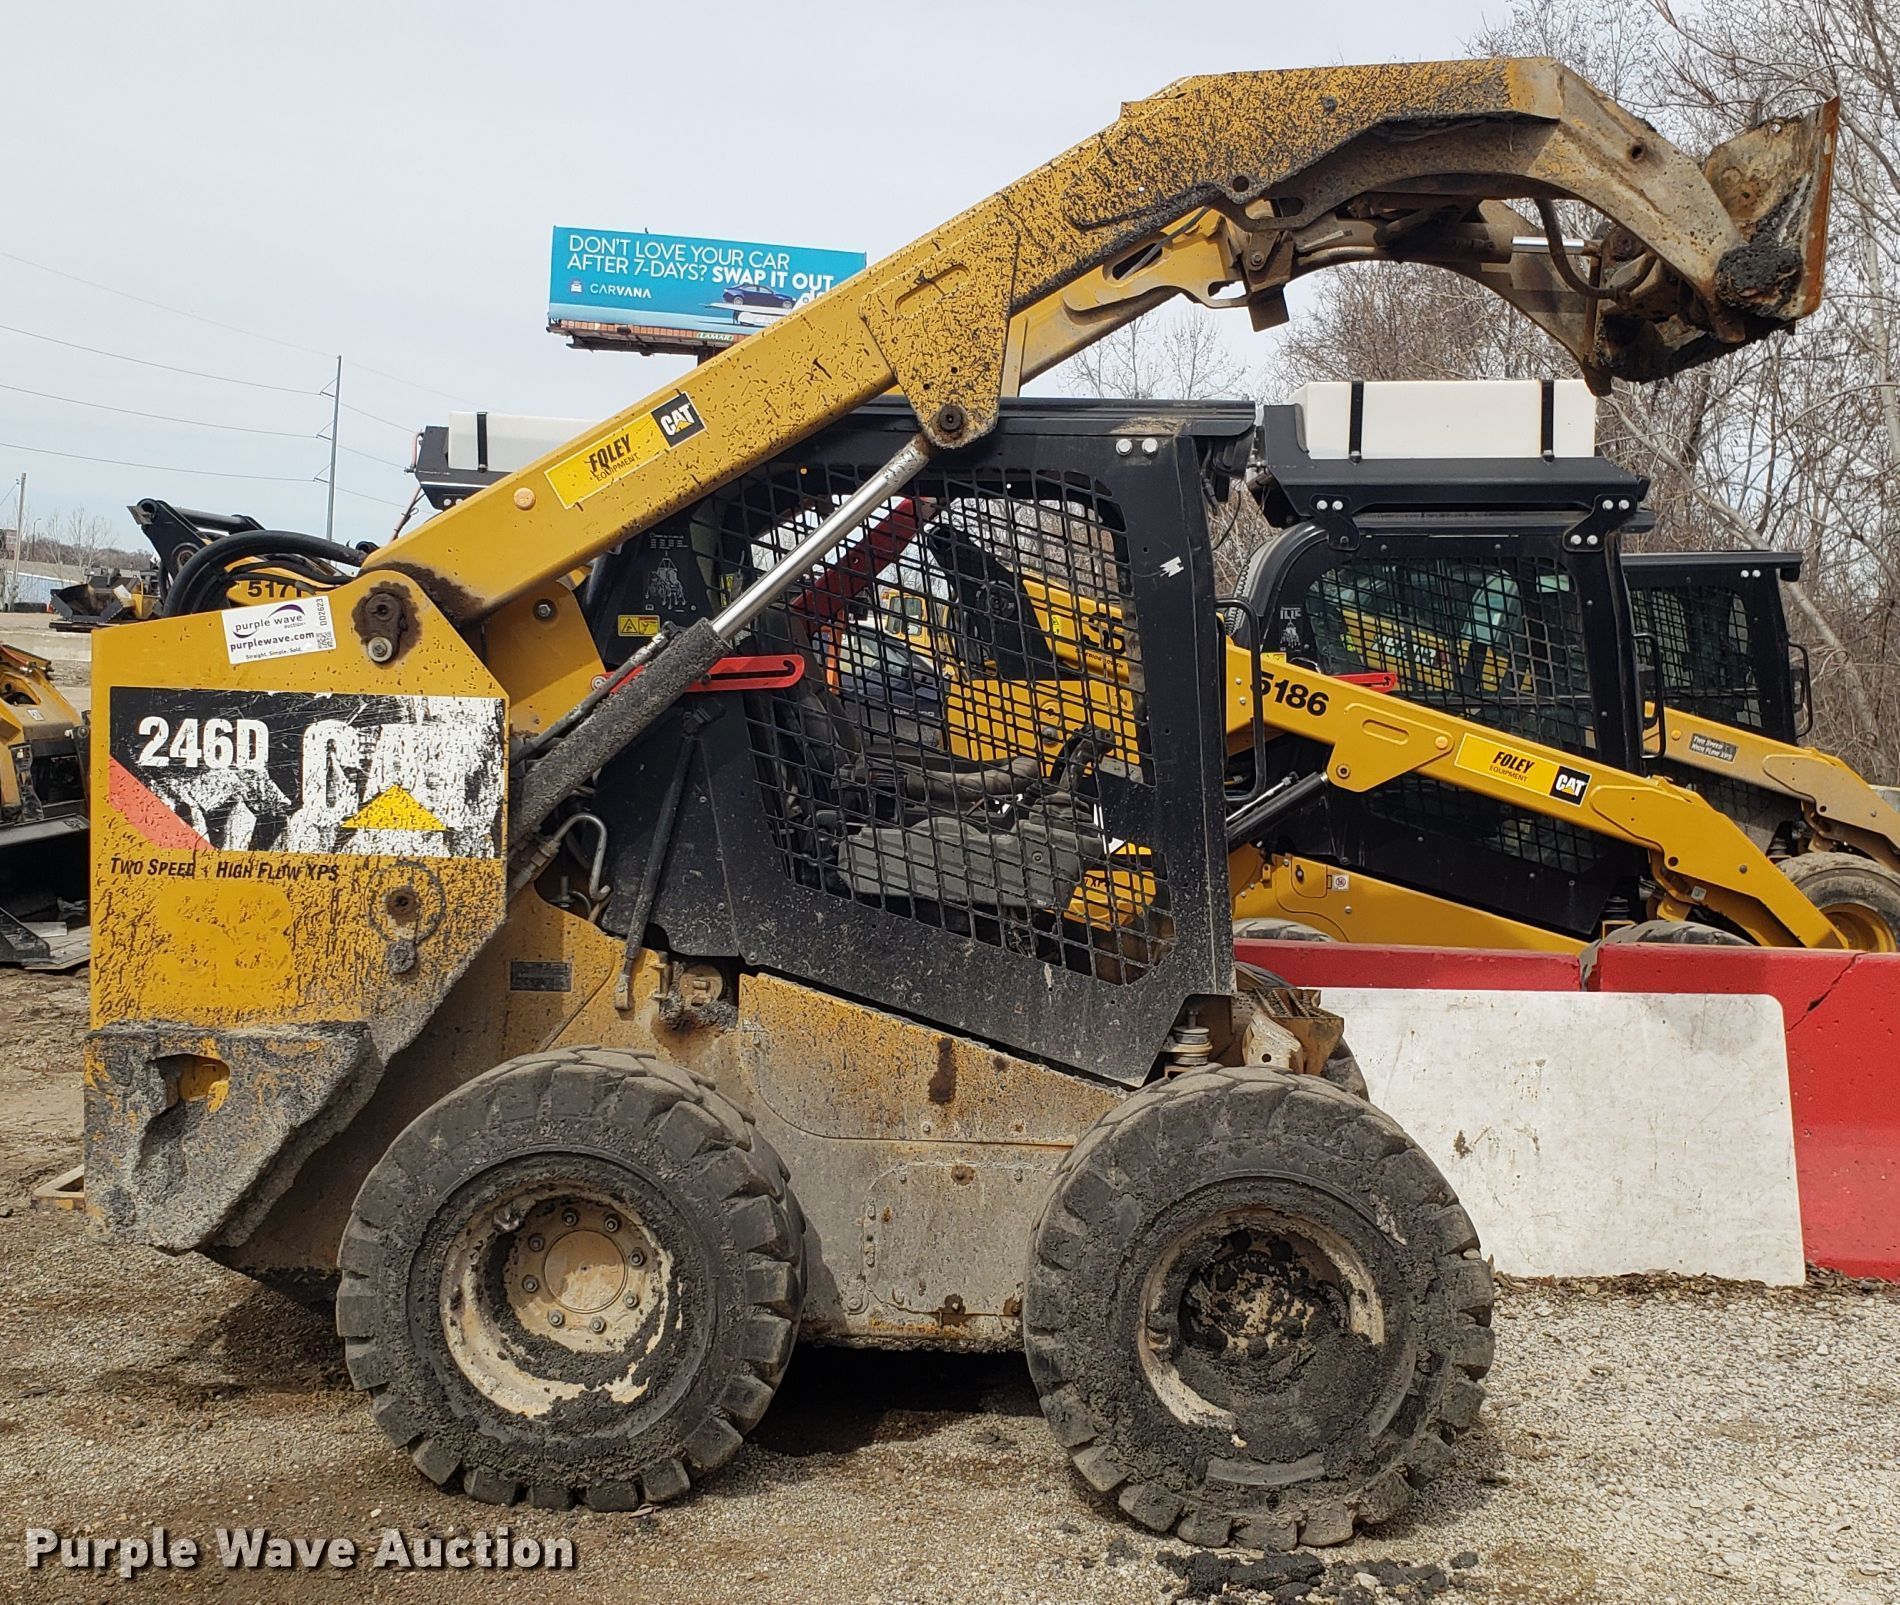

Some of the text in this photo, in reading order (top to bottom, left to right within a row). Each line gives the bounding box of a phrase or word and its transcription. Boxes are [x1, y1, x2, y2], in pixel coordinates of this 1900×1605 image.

[570, 235, 790, 270] DON'T LOVE YOUR CAR
[567, 253, 834, 292] AFTER 7-DAYS? SWAP IT OUT
[590, 283, 652, 298] CARVANA
[660, 403, 695, 436] CAT
[589, 434, 632, 472] FOLEY
[595, 452, 640, 482] EQUIPMENT
[235, 614, 303, 632] purple wave
[230, 631, 315, 652] purplewave.com
[138, 716, 270, 769] 246D
[1489, 765, 1527, 782] EQUIPMENT
[1492, 751, 1535, 774] FOLEY
[1555, 774, 1585, 797] CAT
[306, 863, 340, 882] XPS
